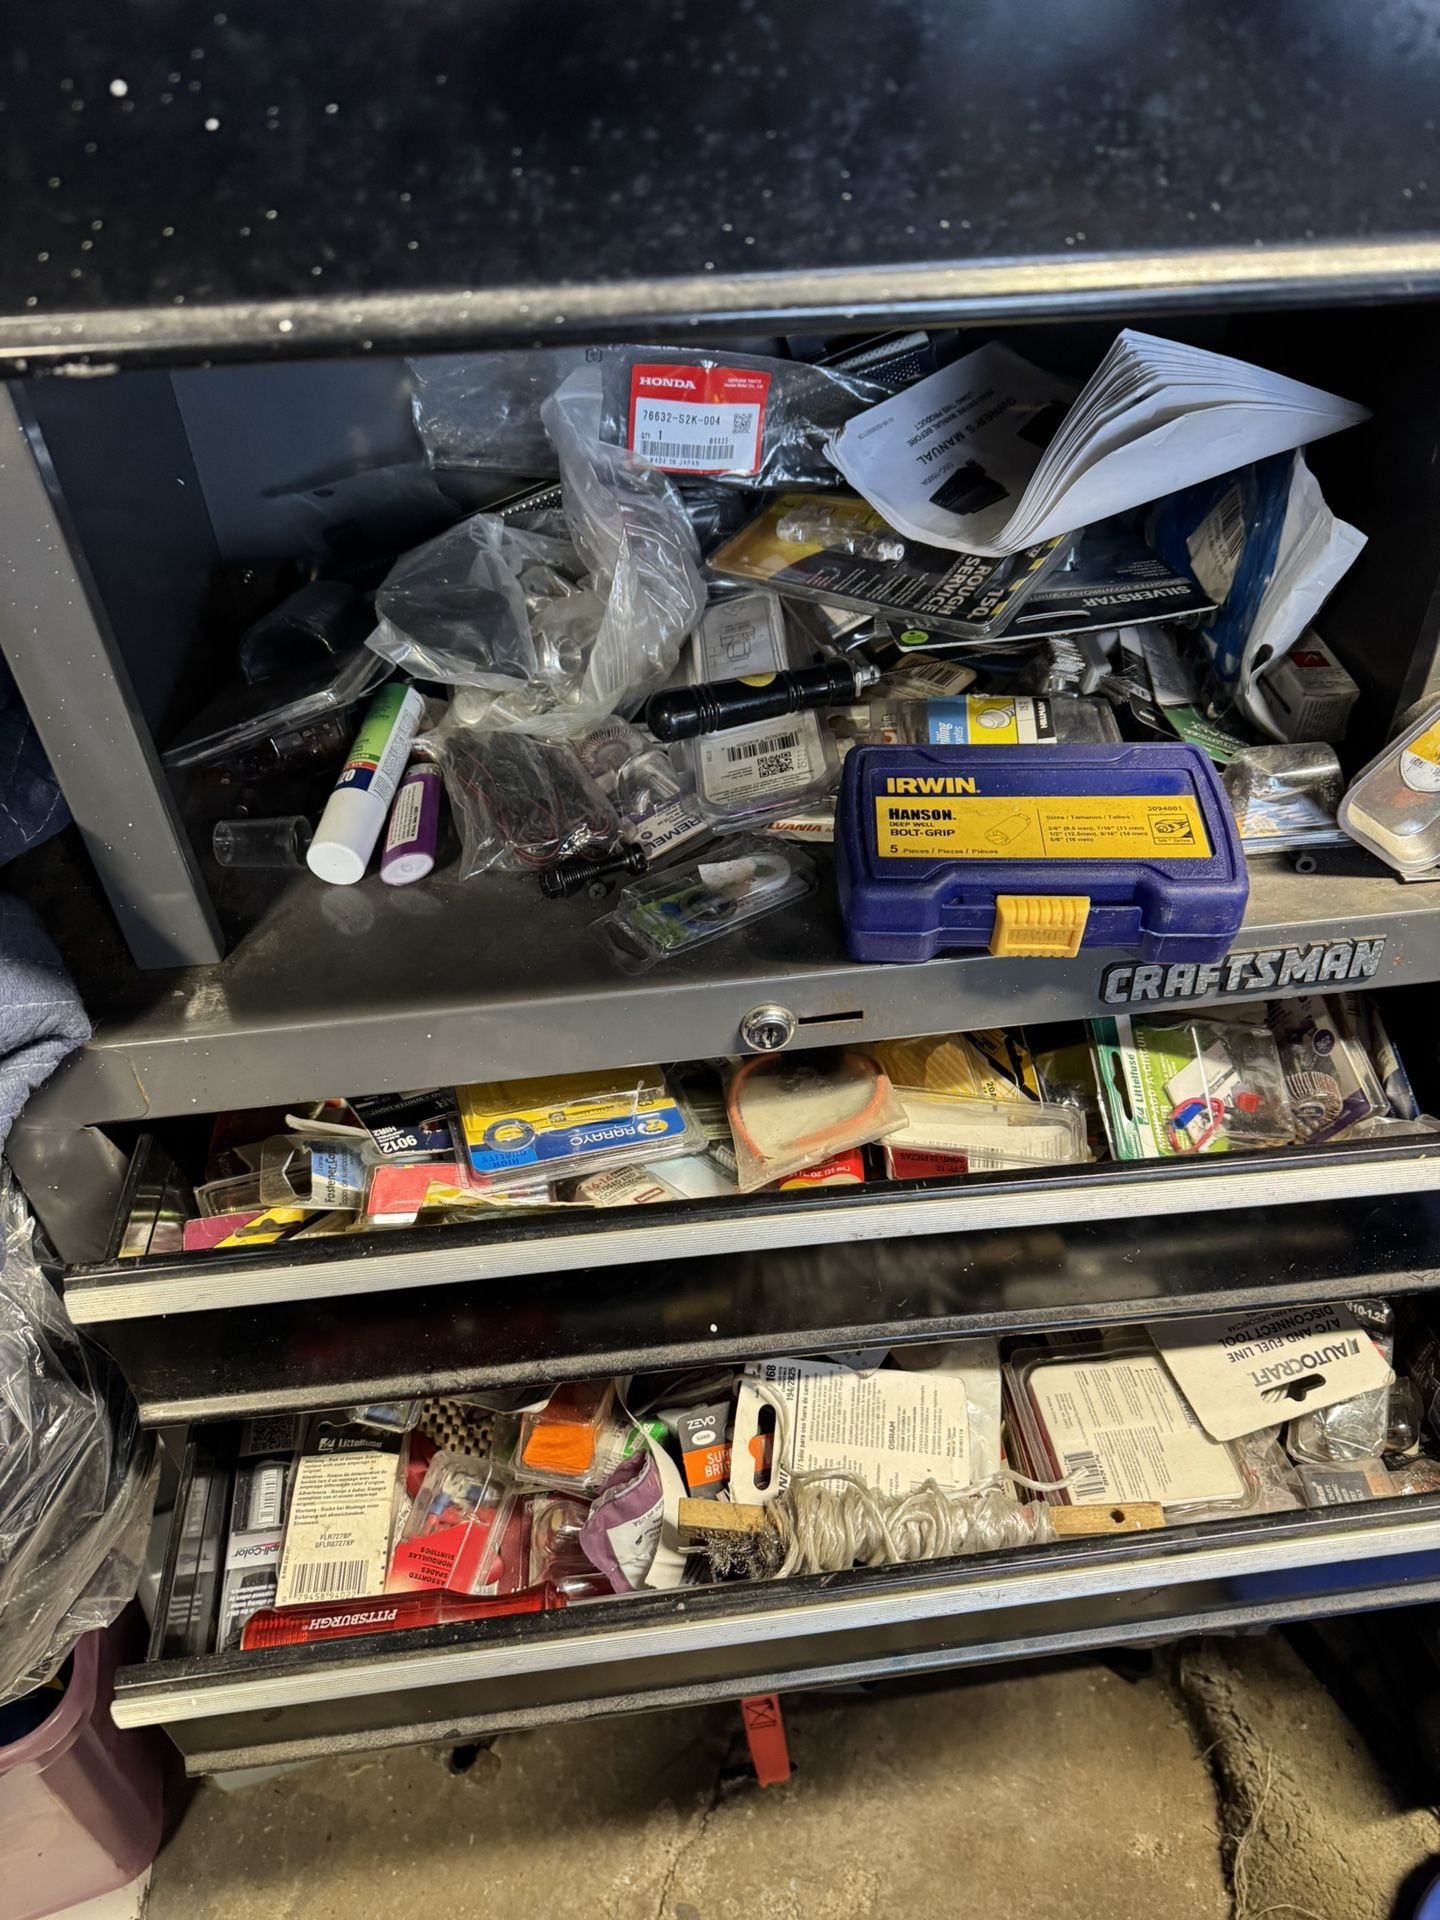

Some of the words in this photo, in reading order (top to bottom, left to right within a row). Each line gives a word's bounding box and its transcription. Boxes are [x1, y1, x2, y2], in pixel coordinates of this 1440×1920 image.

[639, 377, 696, 390] HONDA
[643, 409, 720, 426] 76632-S2K-004
[658, 430, 662, 441] 1
[914, 429, 966, 468] MANUAL
[679, 459, 700, 467] JAPAN
[919, 554, 981, 614] SERVICE
[936, 563, 992, 616] ROUGH
[1081, 584, 1191, 607] SILVERSTAR
[886, 777, 976, 793] IRWIN
[887, 807, 952, 822] HANSON
[890, 828, 955, 836] BOLT-GRIP
[889, 844, 898, 853] 5
[1104, 938, 1385, 1005] CRAFTSMAN
[1131, 1053, 1146, 1108] Littelfuse
[371, 1124, 396, 1136] HIR2
[379, 1133, 418, 1154] 9012
[491, 1157, 519, 1168] HIGH
[324, 1164, 337, 1203] Fastener
[620, 1170, 636, 1182] END
[1253, 1303, 1333, 1338] DISCONNECT
[1313, 1316, 1341, 1335] A/C
[1217, 1329, 1253, 1350] TOOL
[1284, 1326, 1313, 1344] AND
[1253, 1335, 1284, 1355] FUEL
[1225, 1345, 1254, 1364] LINE
[765, 1364, 776, 1382] 168
[1249, 1341, 1348, 1388] AUTOCRAFT
[785, 1366, 796, 1401] 194/2825
[801, 1374, 810, 1395] camino
[801, 1396, 808, 1404] de
[685, 1414, 716, 1430] ZEVO
[800, 1405, 808, 1421] fuera
[337, 1438, 382, 1448] Littelfuse
[886, 1420, 897, 1450] OSRAM
[407, 1551, 452, 1567] HORQUILLAS
[419, 1546, 455, 1560] SURTIDOS
[408, 1571, 445, 1586] ASSORTED
[420, 1566, 448, 1578] SPADES
[308, 1607, 399, 1630] PITTSBURGH
